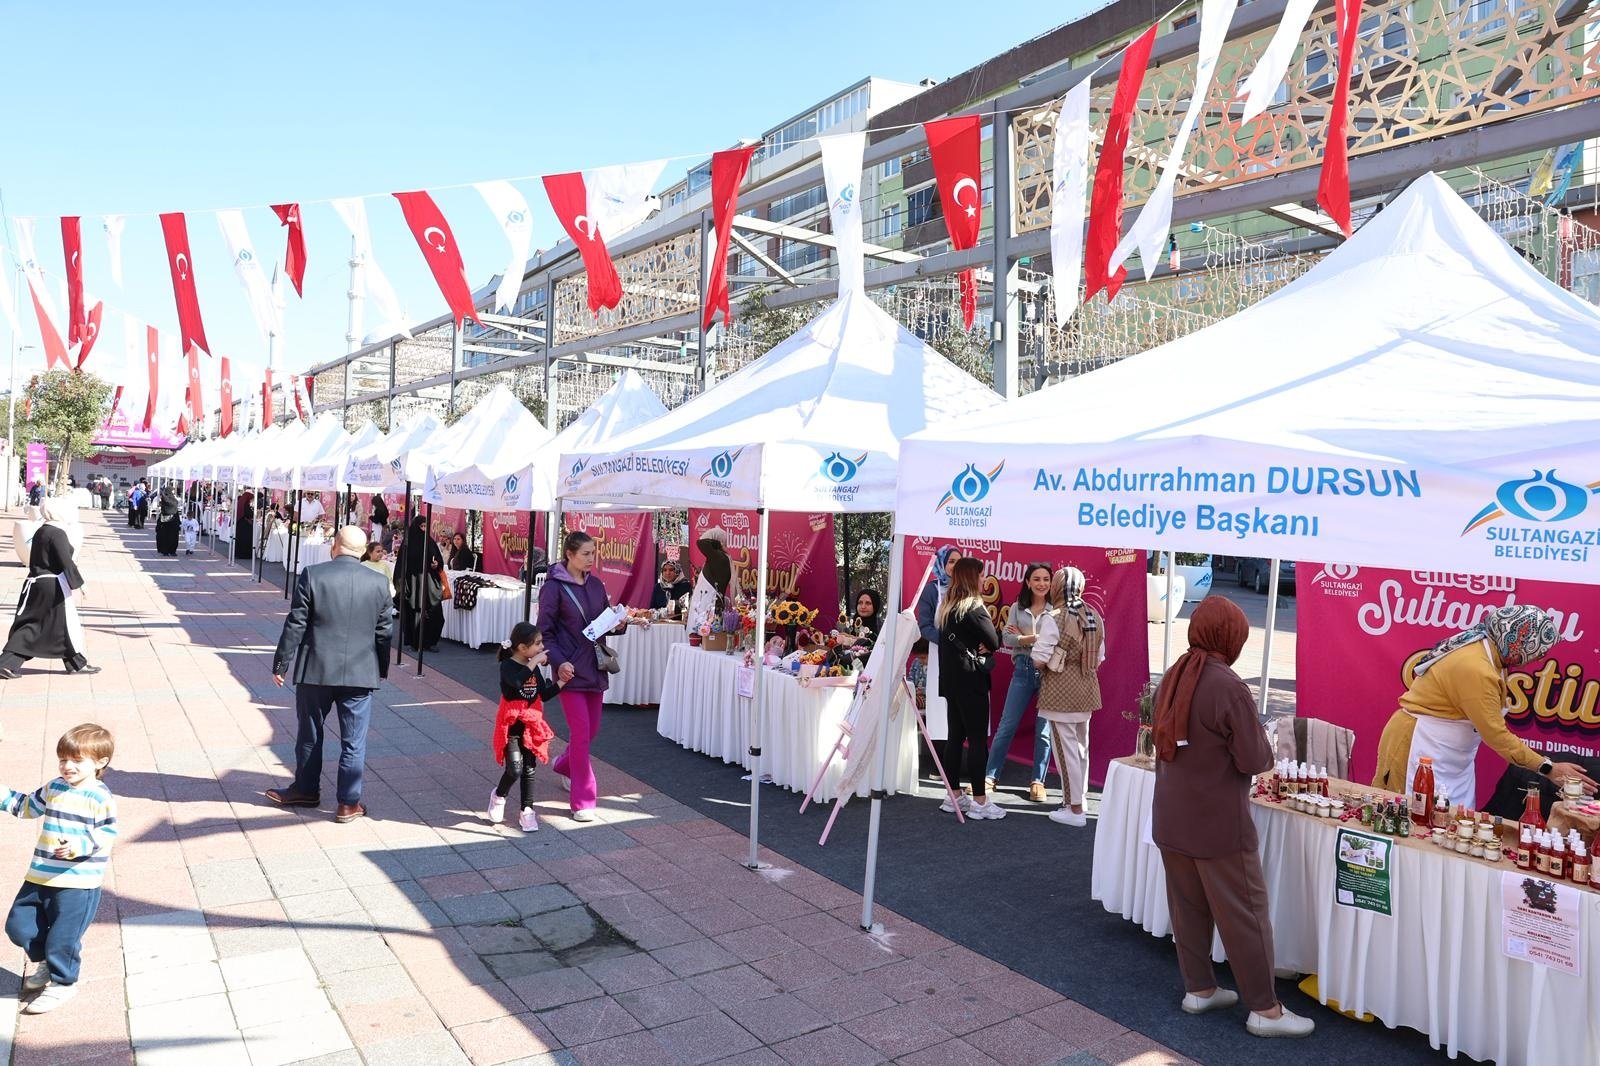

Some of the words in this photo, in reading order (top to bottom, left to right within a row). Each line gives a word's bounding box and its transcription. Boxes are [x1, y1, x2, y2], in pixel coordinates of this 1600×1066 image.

[591, 452, 634, 477] SULTANGAZİ
[635, 455, 690, 477] BELEDİYESİ
[1033, 468, 1066, 491] Av.
[1072, 466, 1255, 493] Abdurrahman
[1267, 466, 1421, 498] DURSUN
[945, 505, 993, 518] SULTANGAZİ
[721, 512, 750, 530] Emeğin
[949, 516, 987, 528] BELEDİYESİ
[1078, 502, 1186, 536] Belediye
[1196, 504, 1318, 540] Başkanı
[1494, 544, 1589, 562] BELEDİYESİ
[1320, 580, 1363, 591] SULTANGAZİ
[1324, 588, 1359, 598] BELEDİYESİ
